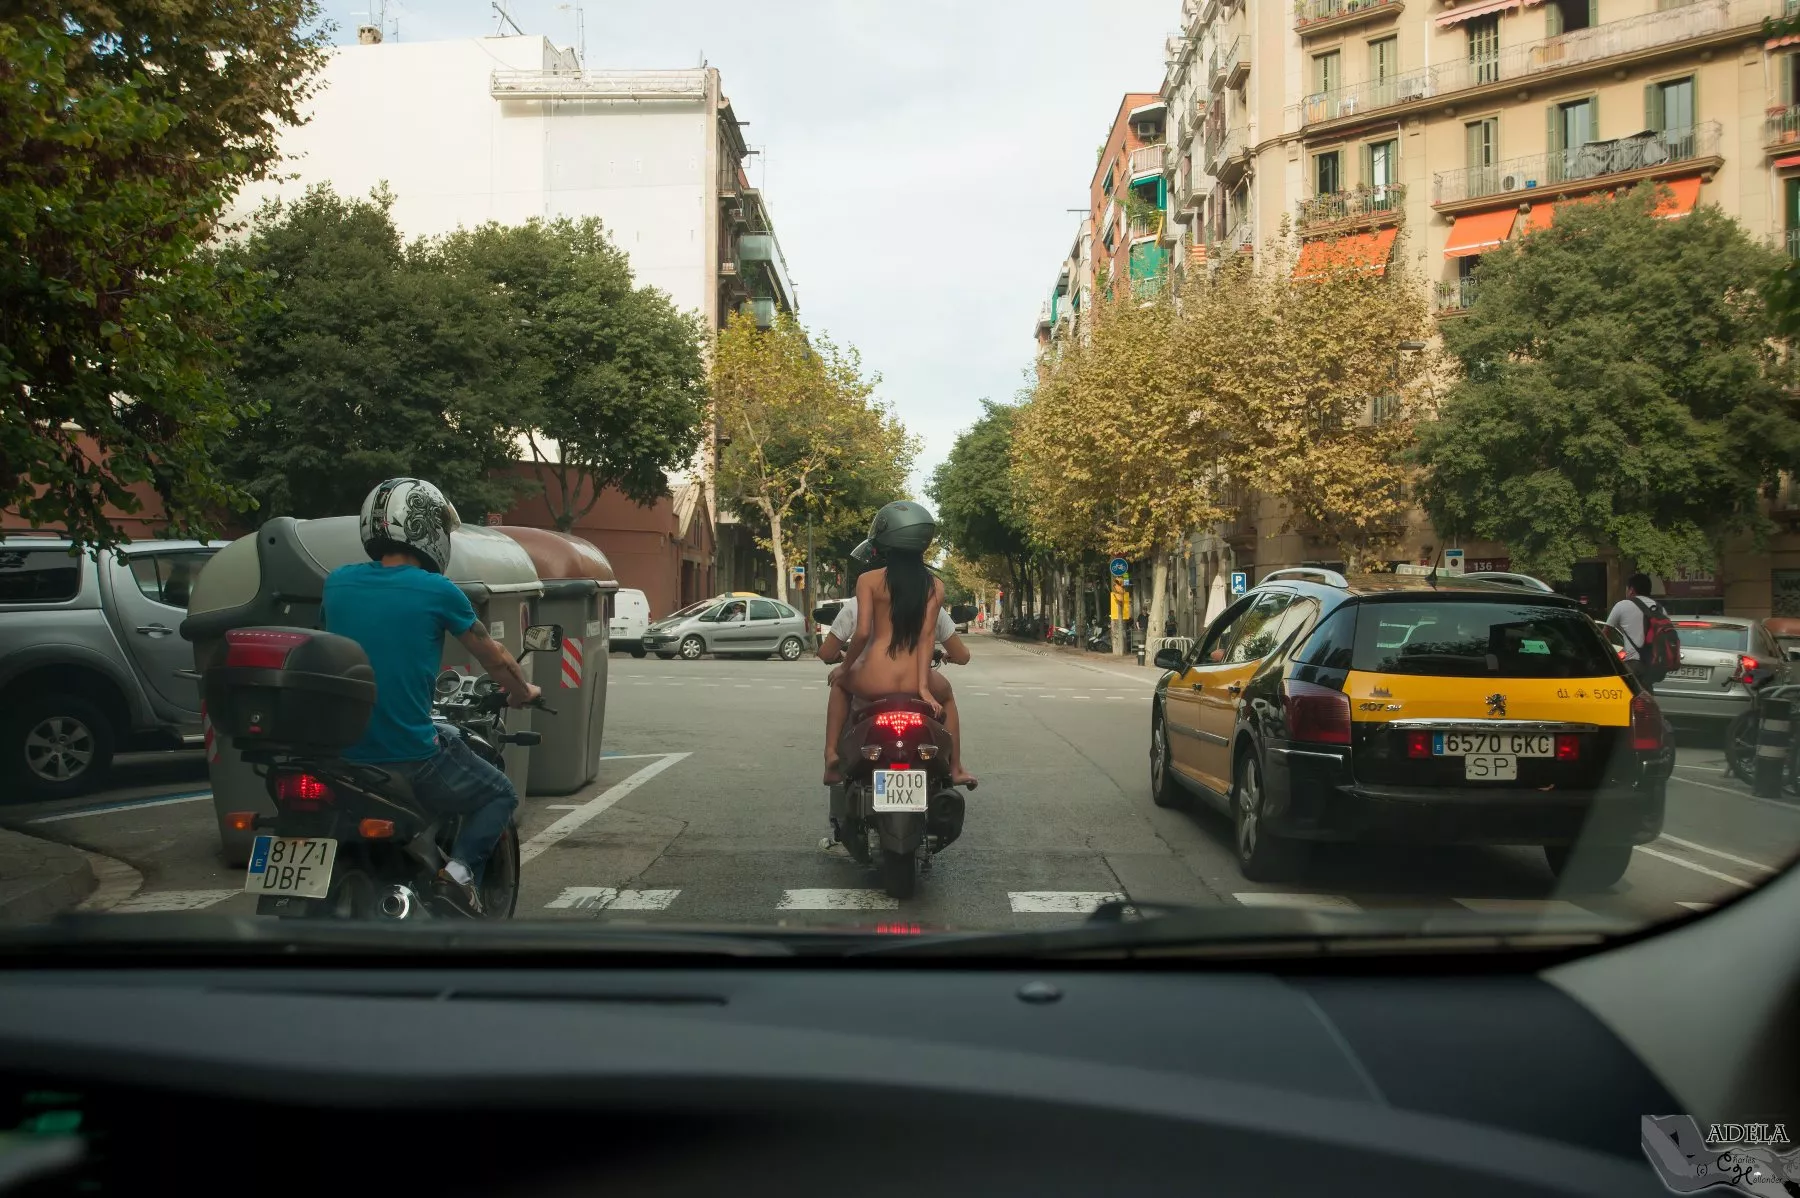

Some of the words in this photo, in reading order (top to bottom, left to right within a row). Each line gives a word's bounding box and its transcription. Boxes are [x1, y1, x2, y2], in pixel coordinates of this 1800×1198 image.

[1473, 562, 1493, 571] 136
[1235, 575, 1242, 585] P
[1593, 689, 1623, 699] 5097
[1358, 702, 1385, 711] 407
[1447, 733, 1501, 753] 6570
[1511, 735, 1550, 754] GKC
[1473, 758, 1509, 776] SP
[886, 773, 923, 788] 7010
[886, 789, 913, 804] HXX
[271, 840, 328, 866] 8171
[255, 858, 263, 867] E
[263, 865, 312, 891] DBF
